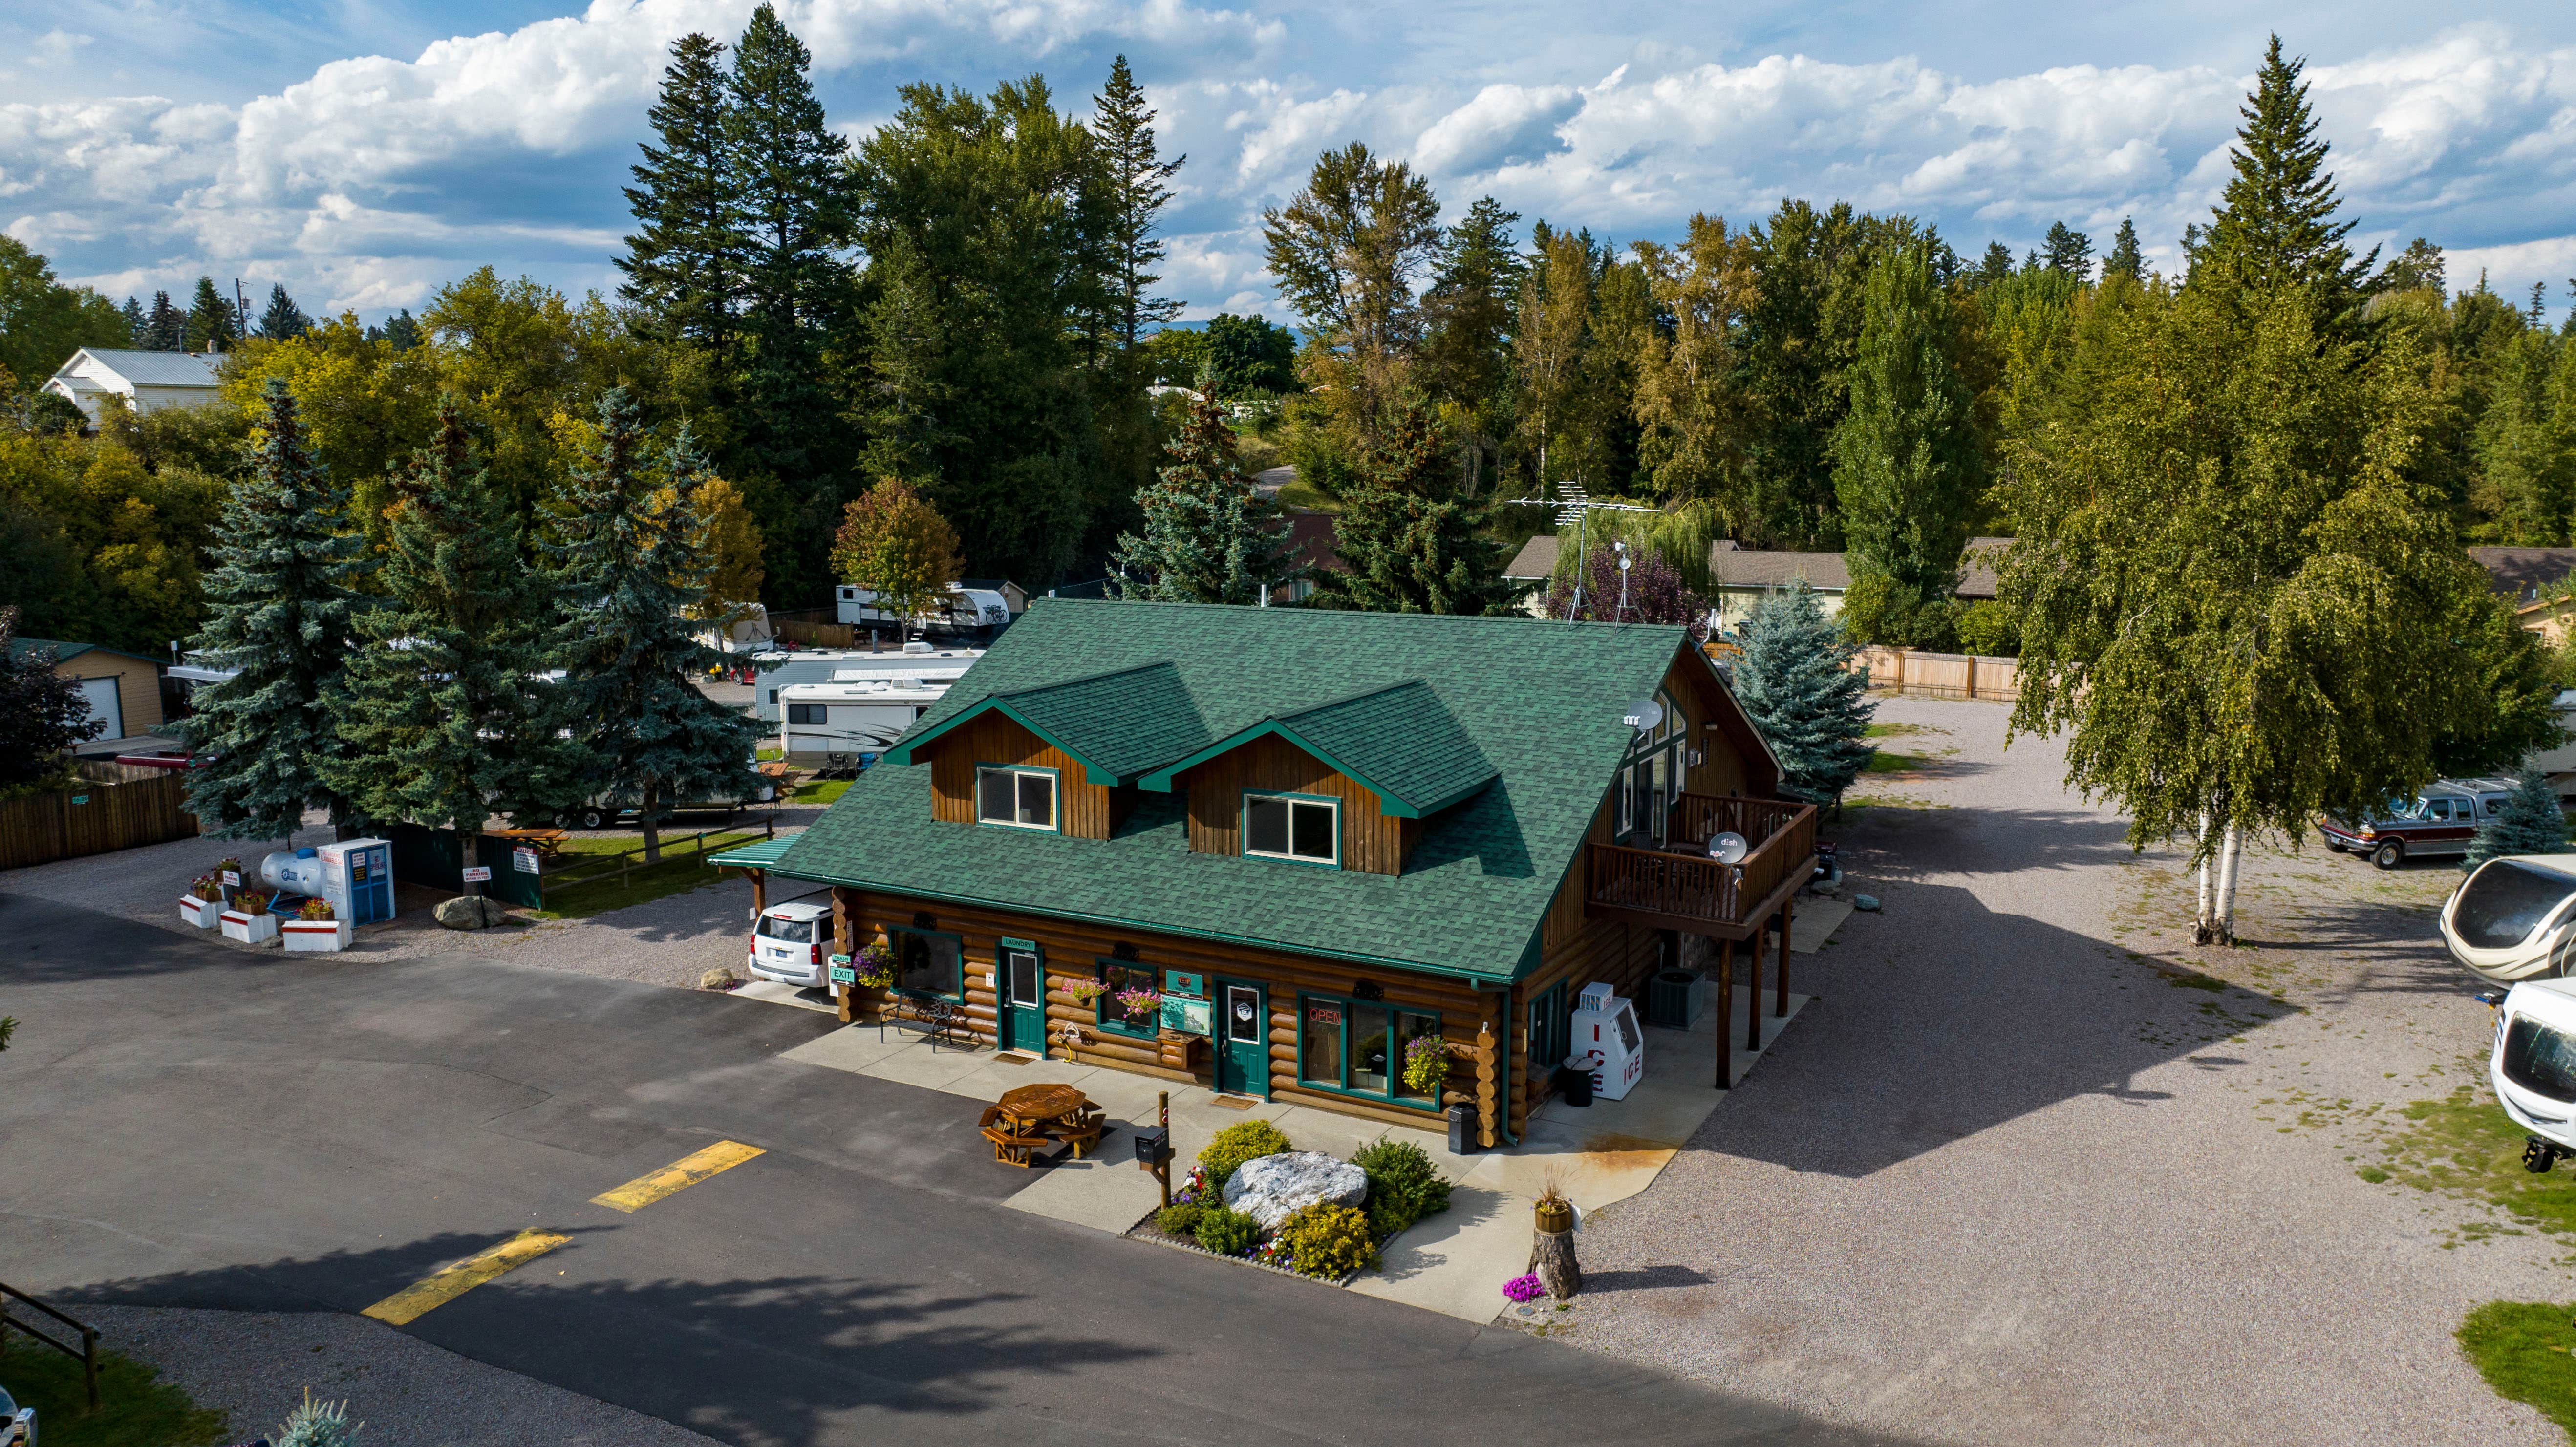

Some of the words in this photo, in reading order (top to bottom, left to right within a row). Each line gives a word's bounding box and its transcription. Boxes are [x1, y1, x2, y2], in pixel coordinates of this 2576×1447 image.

[1006, 939, 1031, 948] LAUNDRY
[834, 969, 851, 979] EXIT
[1309, 1008, 1341, 1024] OPEN
[1624, 1053, 1640, 1085] ICE
